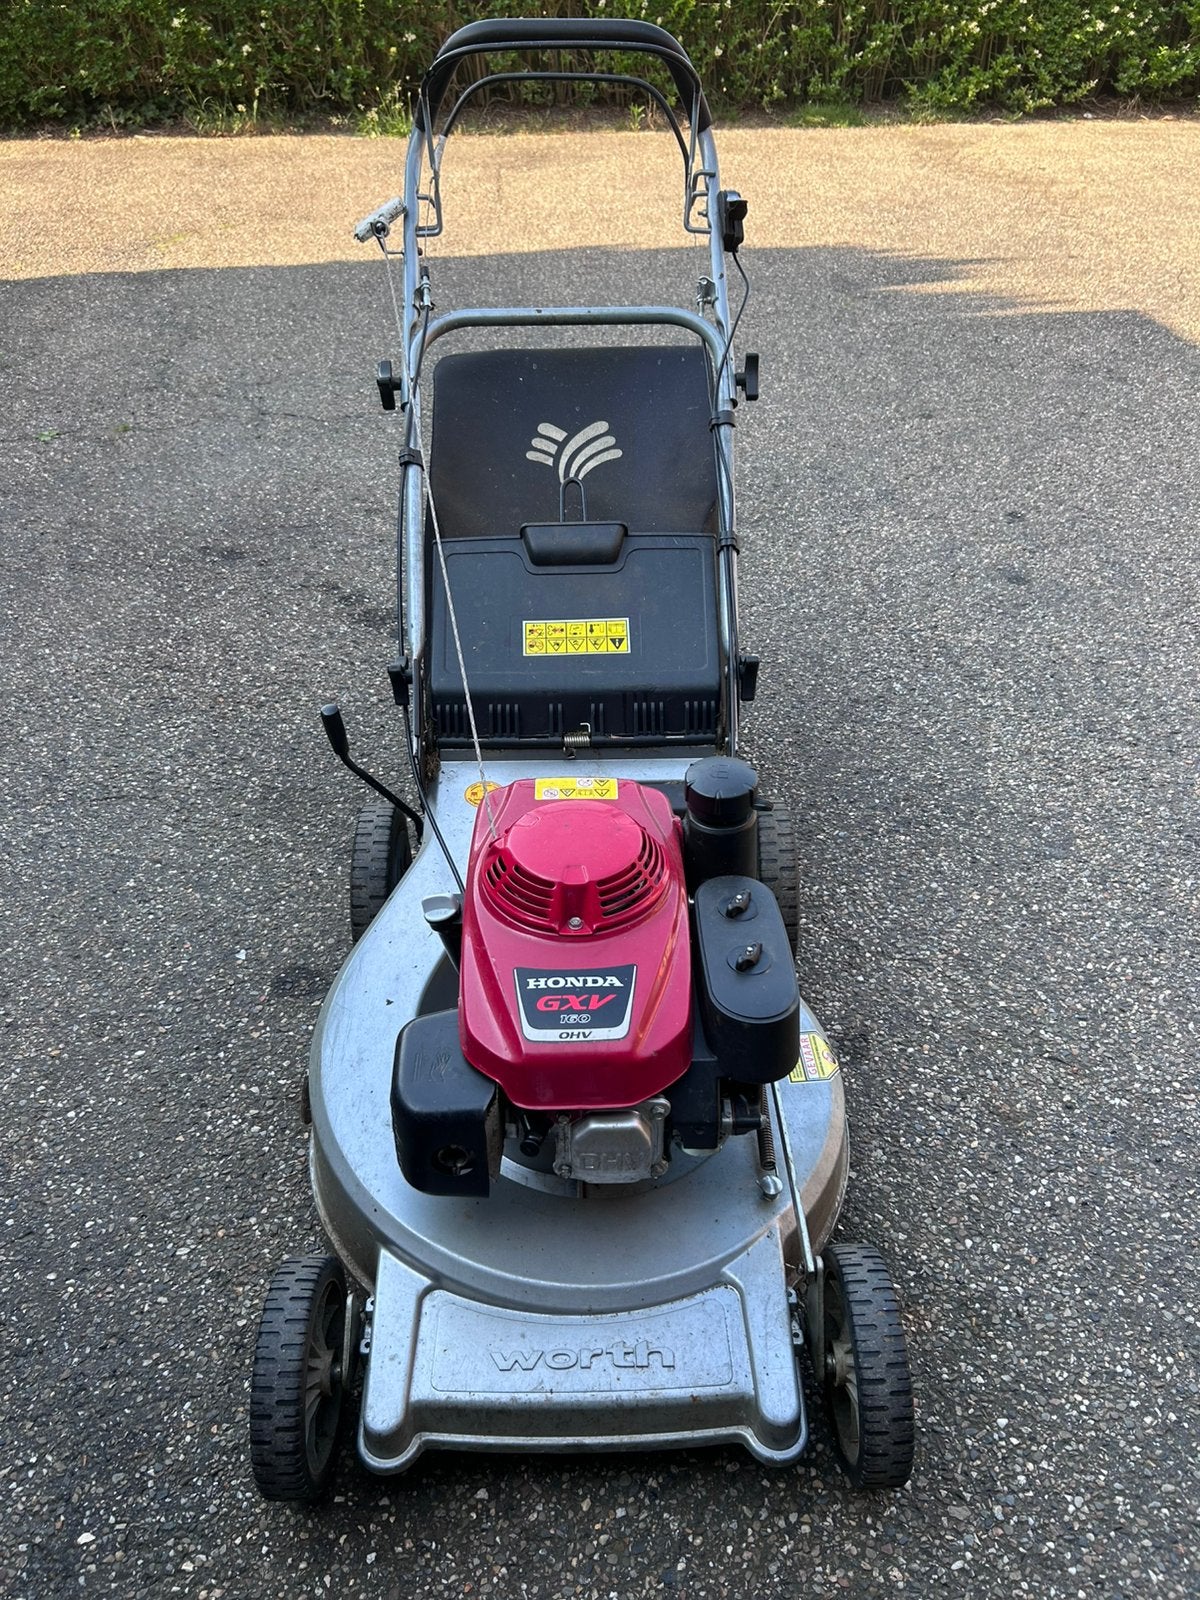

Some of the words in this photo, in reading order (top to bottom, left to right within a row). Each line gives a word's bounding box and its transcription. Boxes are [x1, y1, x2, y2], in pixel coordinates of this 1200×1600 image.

[526, 976, 624, 989] HONDA
[536, 994, 617, 1011] GXV
[560, 1013, 591, 1024] 160
[558, 1031, 592, 1039] OHV
[800, 1037, 817, 1075] GEVAAR
[489, 1340, 676, 1372] worth
